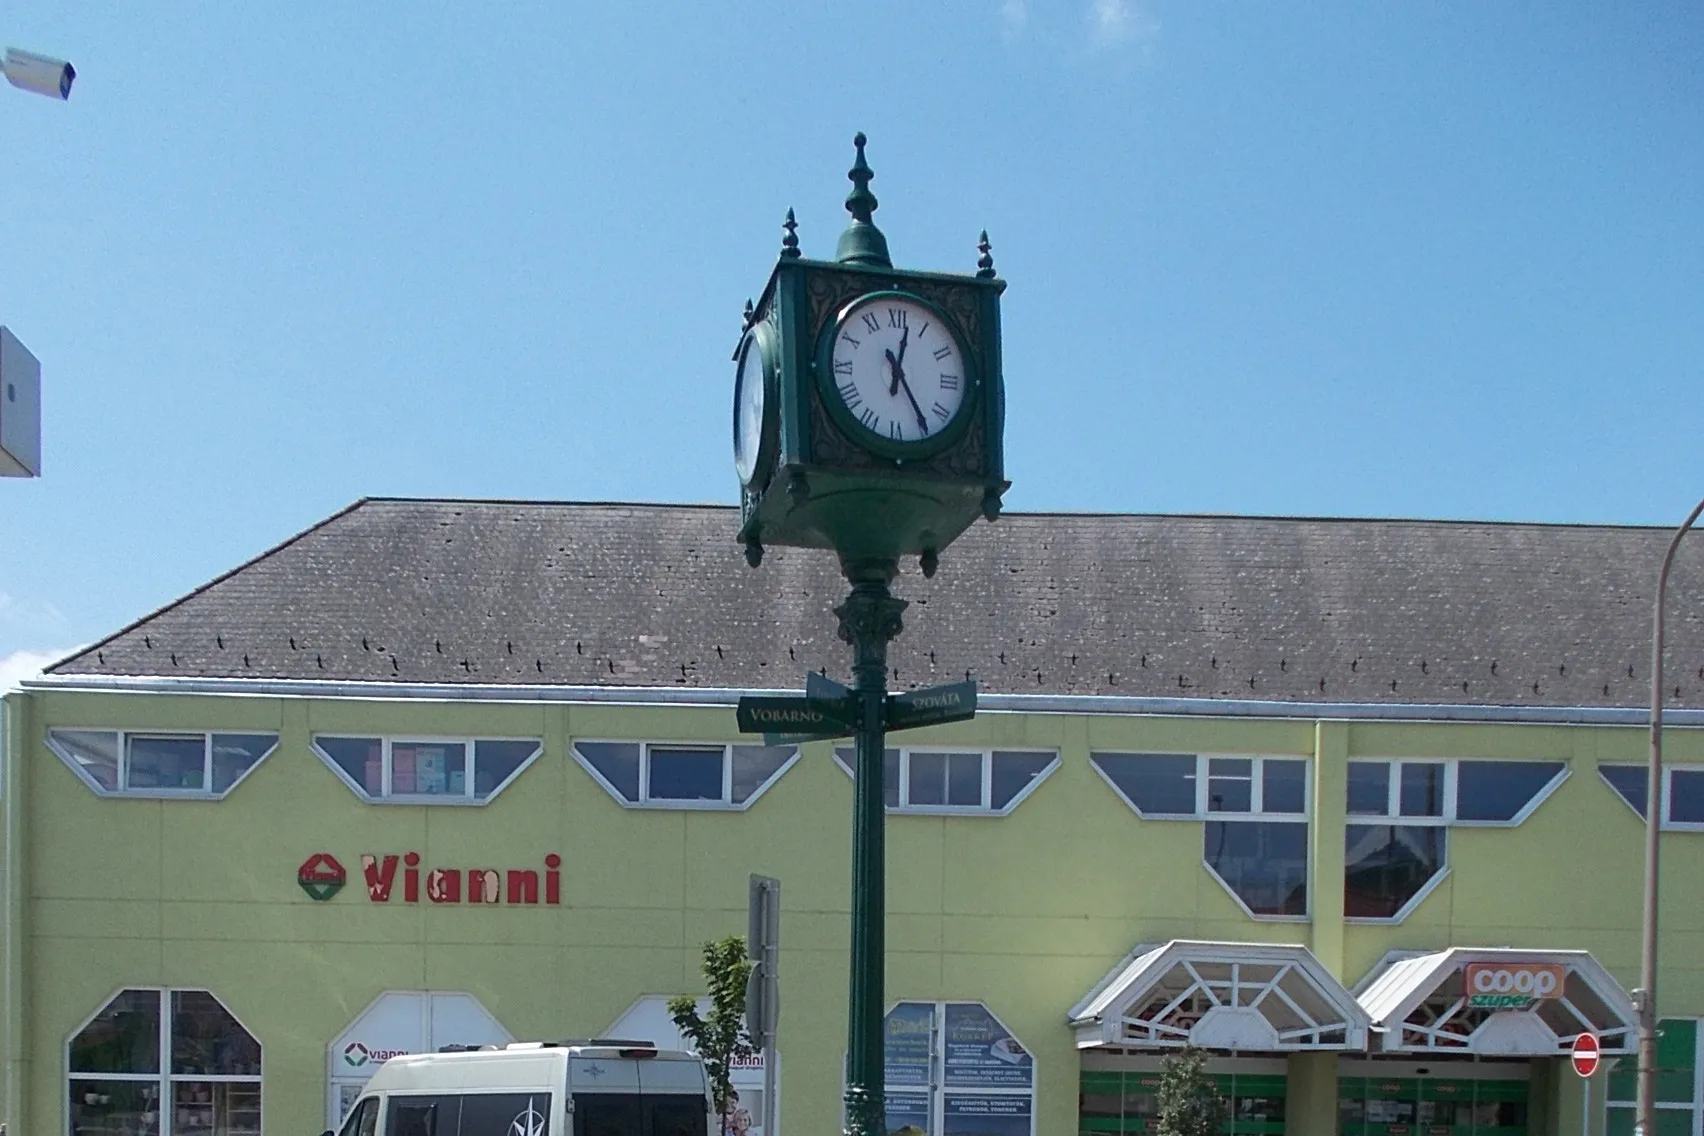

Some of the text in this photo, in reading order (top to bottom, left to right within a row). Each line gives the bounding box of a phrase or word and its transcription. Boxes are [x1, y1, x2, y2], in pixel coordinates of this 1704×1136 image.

[862, 312, 880, 335] XI
[888, 308, 907, 329] XII
[918, 321, 929, 339] I
[842, 331, 860, 350] X
[933, 345, 952, 362] II
[834, 359, 853, 376] IX
[940, 373, 958, 391] III
[750, 708, 823, 724] VOBARNO
[361, 852, 561, 904] Vianni
[1474, 969, 1557, 999] coop
[1470, 994, 1532, 1008] szuper
